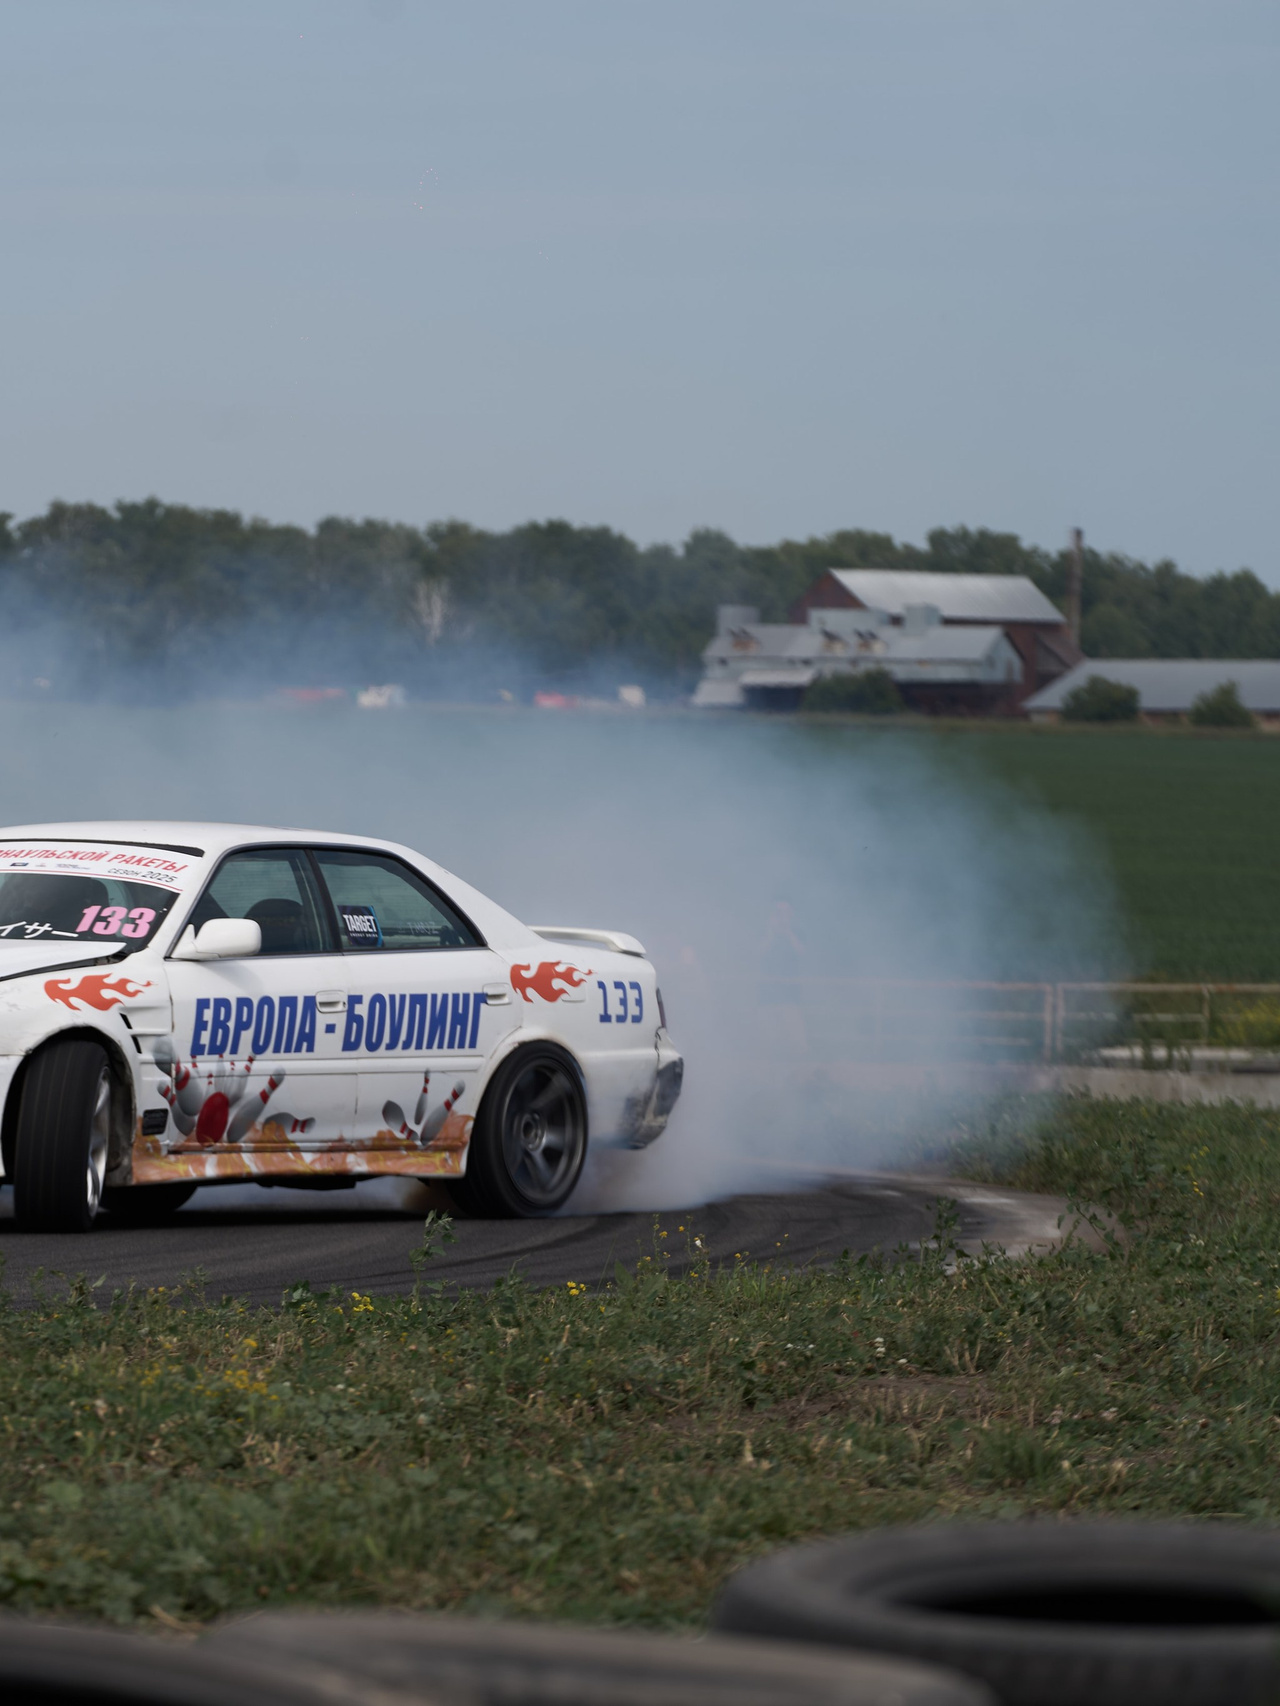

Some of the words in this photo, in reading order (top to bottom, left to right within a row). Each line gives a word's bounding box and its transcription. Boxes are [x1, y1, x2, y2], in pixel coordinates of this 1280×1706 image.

[107, 854, 188, 872] РАКЕТЫ
[108, 867, 141, 876] СЕЗОН
[140, 870, 178, 883] 2025
[75, 905, 156, 938] 133
[342, 914, 378, 933] TARGET
[597, 980, 644, 1023] 133
[190, 995, 317, 1055] ЕВРОПА
[341, 992, 489, 1052] БОУЛИНГ
